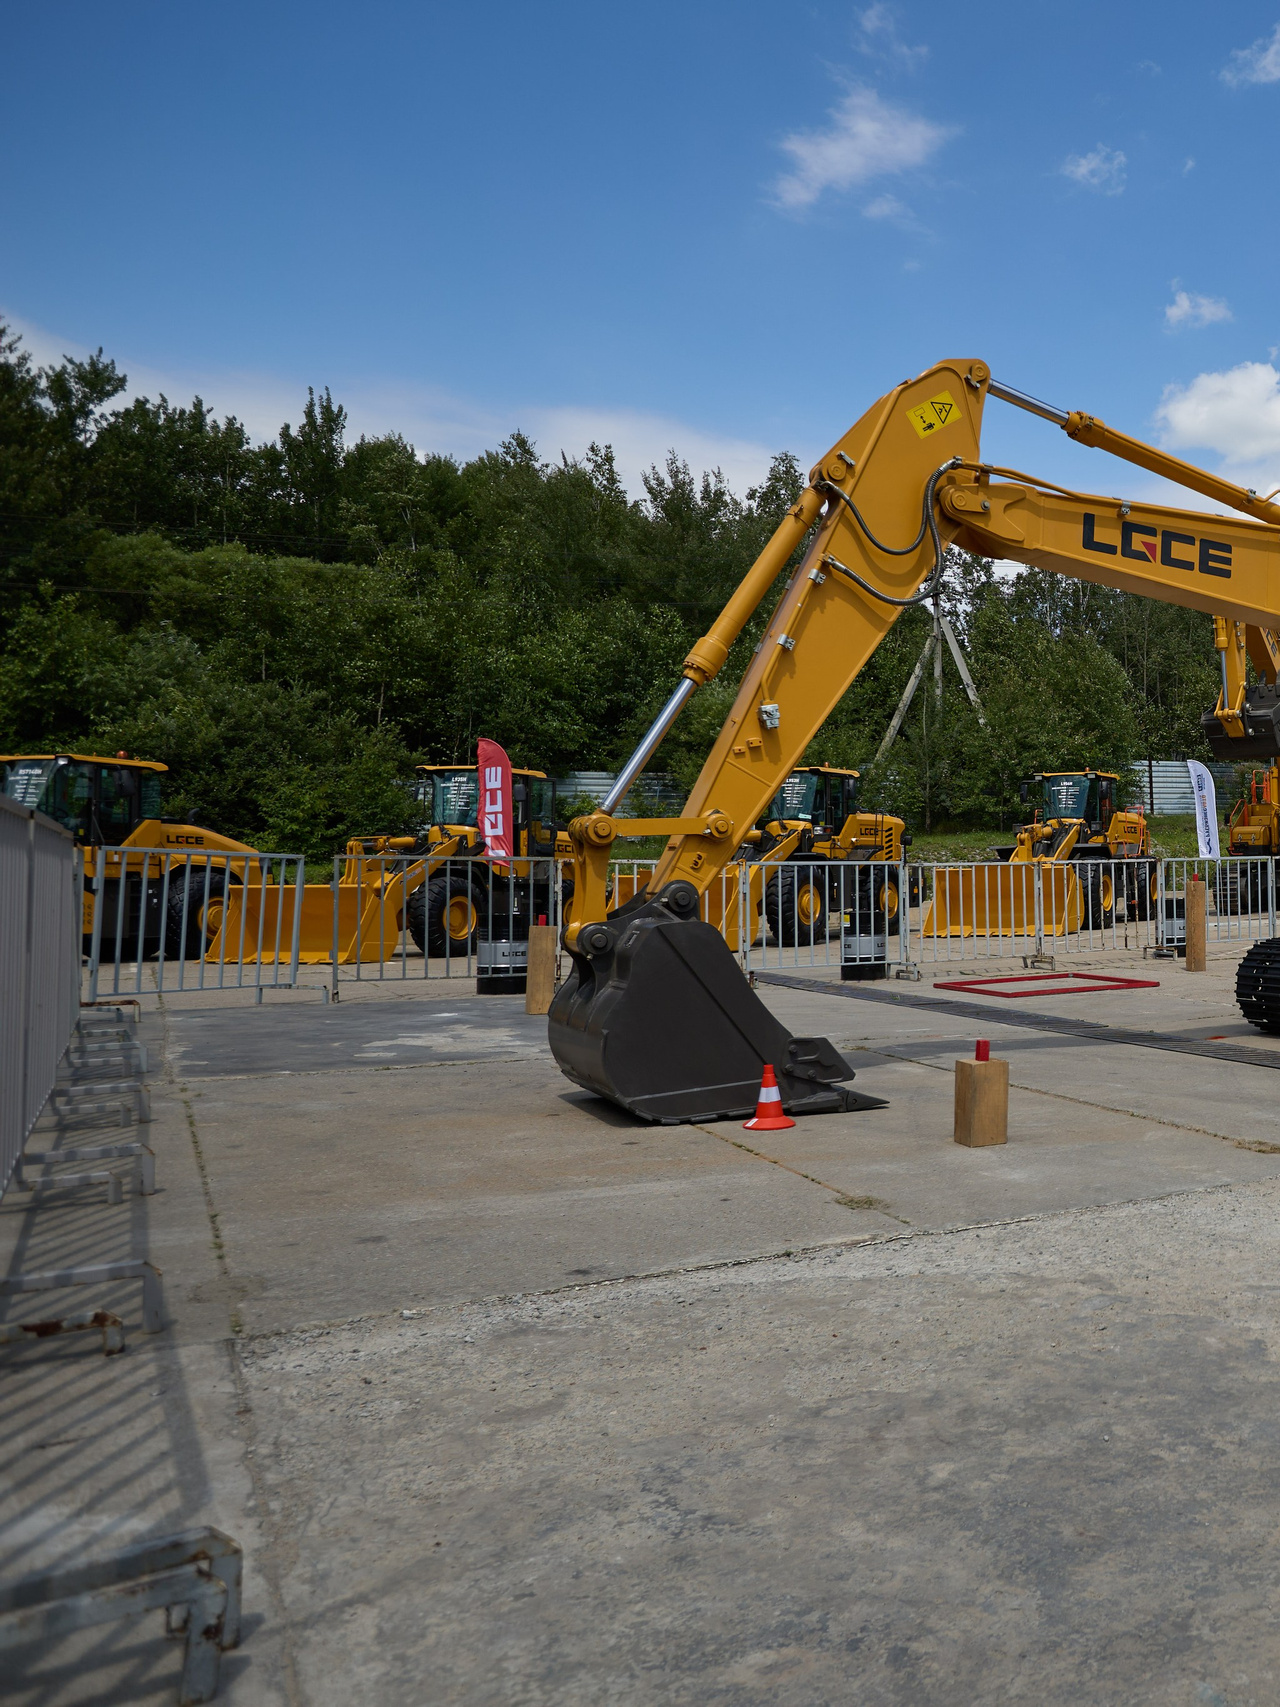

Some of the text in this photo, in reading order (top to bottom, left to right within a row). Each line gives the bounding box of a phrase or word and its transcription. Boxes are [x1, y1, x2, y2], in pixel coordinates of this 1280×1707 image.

[1082, 512, 1232, 579] LGCE
[484, 766, 505, 857] LGCE
[166, 834, 205, 845] LGCE
[859, 828, 879, 836] LGCE
